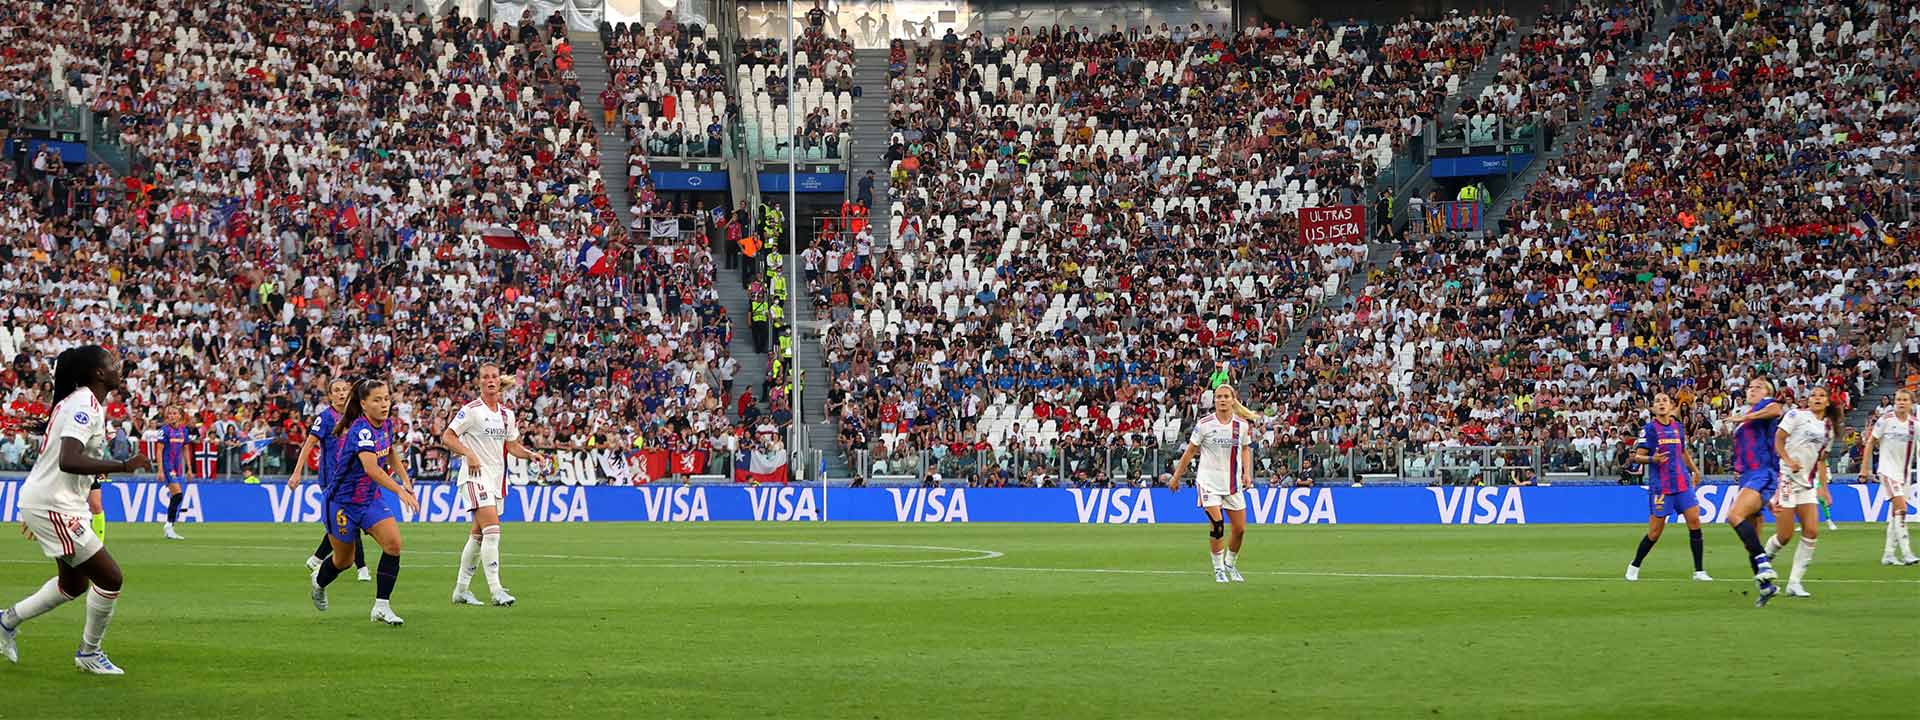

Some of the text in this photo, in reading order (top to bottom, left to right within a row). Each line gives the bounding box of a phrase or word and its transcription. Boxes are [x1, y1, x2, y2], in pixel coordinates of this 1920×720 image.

[1310, 208, 1352, 222] ULTRAS
[1329, 222, 1359, 238] ISERA
[261, 484, 323, 522] VIS
[335, 509, 348, 527] 6
[513, 486, 590, 522] VISA
[637, 486, 710, 522] VISA
[744, 487, 818, 522] VISA
[886, 488, 968, 522] VISA
[1066, 488, 1156, 523] VISA
[1246, 487, 1337, 524] VISA
[1426, 487, 1526, 524] VISA
